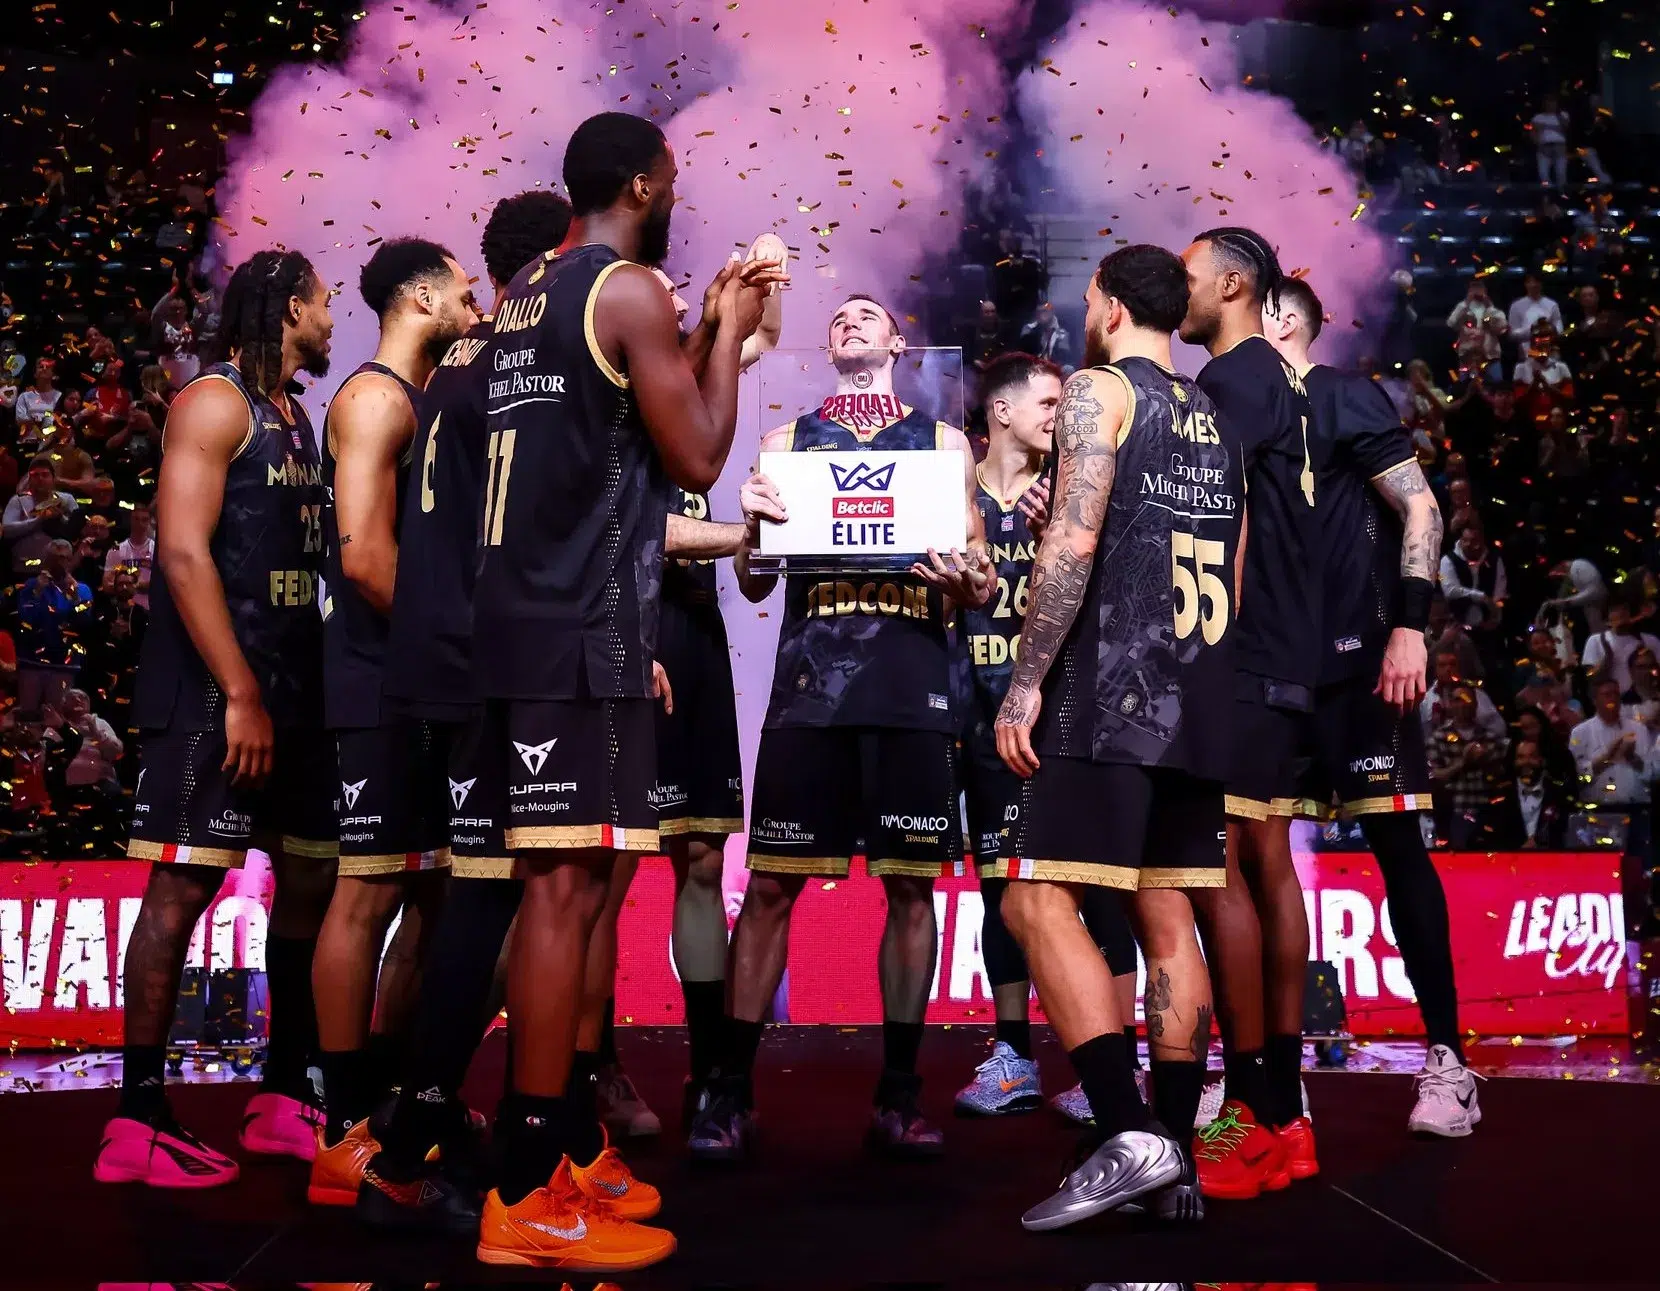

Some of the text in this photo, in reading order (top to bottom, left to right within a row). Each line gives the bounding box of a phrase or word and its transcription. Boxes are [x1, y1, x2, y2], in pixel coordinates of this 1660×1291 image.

[494, 292, 547, 333] DIALLO
[494, 348, 536, 372] GROUPE
[488, 371, 566, 400] ICHEL PASTOR
[1169, 402, 1220, 445] JMES
[483, 428, 517, 547] 11
[836, 501, 890, 515] Betclic
[832, 521, 895, 546] ÉLITE
[270, 570, 317, 606] FED
[992, 575, 1030, 619] 26
[1171, 529, 1229, 646] 55
[968, 634, 1022, 665] EDC
[762, 817, 802, 831] GROUPE
[785, 830, 815, 841] PASTOR
[880, 814, 949, 831] TVMONACO
[905, 834, 939, 845] SPALDING
